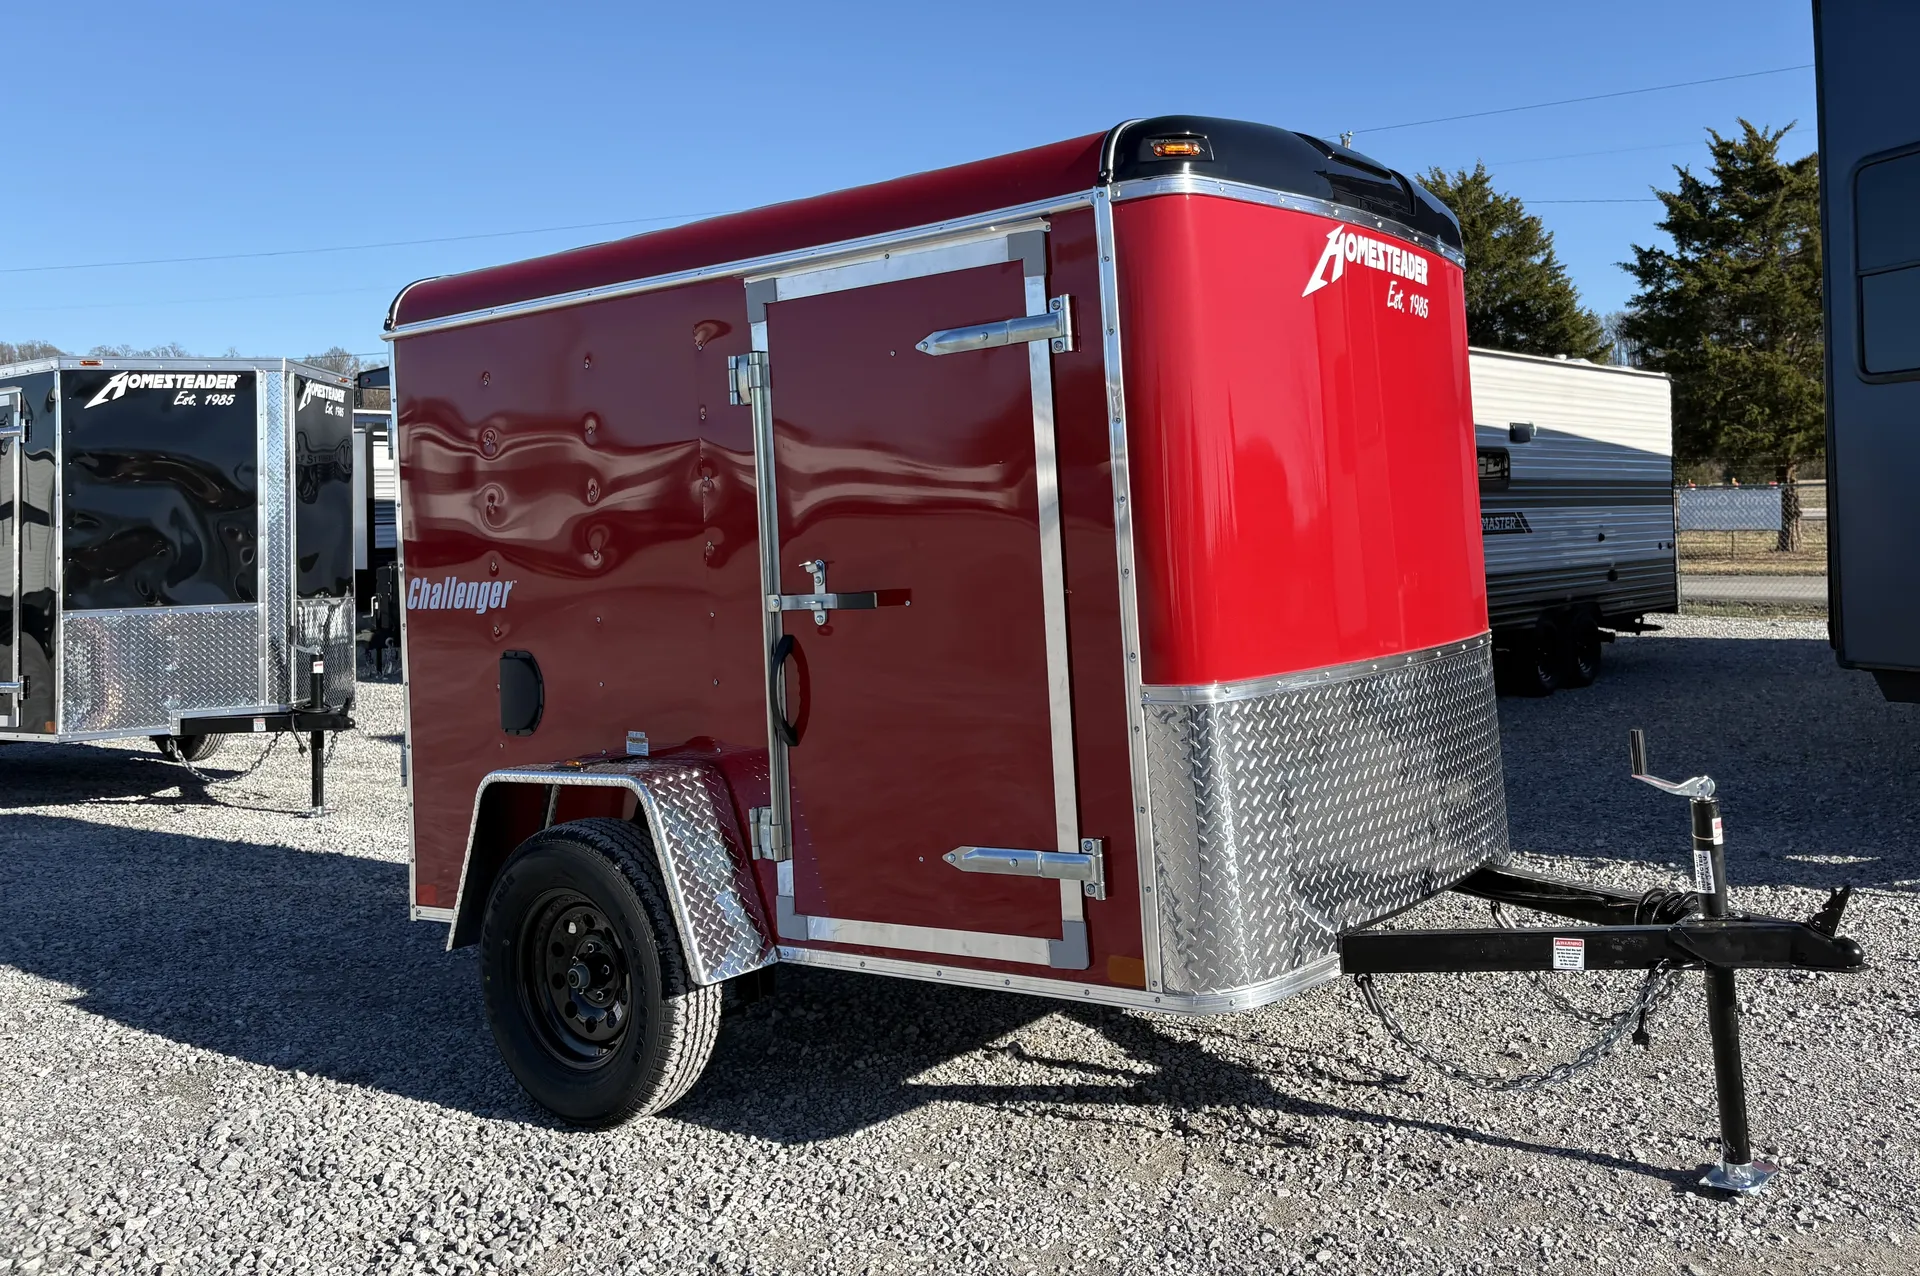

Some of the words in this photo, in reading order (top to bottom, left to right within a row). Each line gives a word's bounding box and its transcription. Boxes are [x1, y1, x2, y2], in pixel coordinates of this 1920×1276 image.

[1301, 224, 1428, 298] HOMESTEADER
[1387, 280, 1405, 313] Est.
[1409, 293, 1429, 319] 1985
[84, 371, 239, 409] HOMESTEADER
[173, 390, 197, 406] Est.
[204, 393, 236, 406] 1985
[298, 379, 346, 411] HOMESTEADER
[406, 576, 514, 614] Challenger
